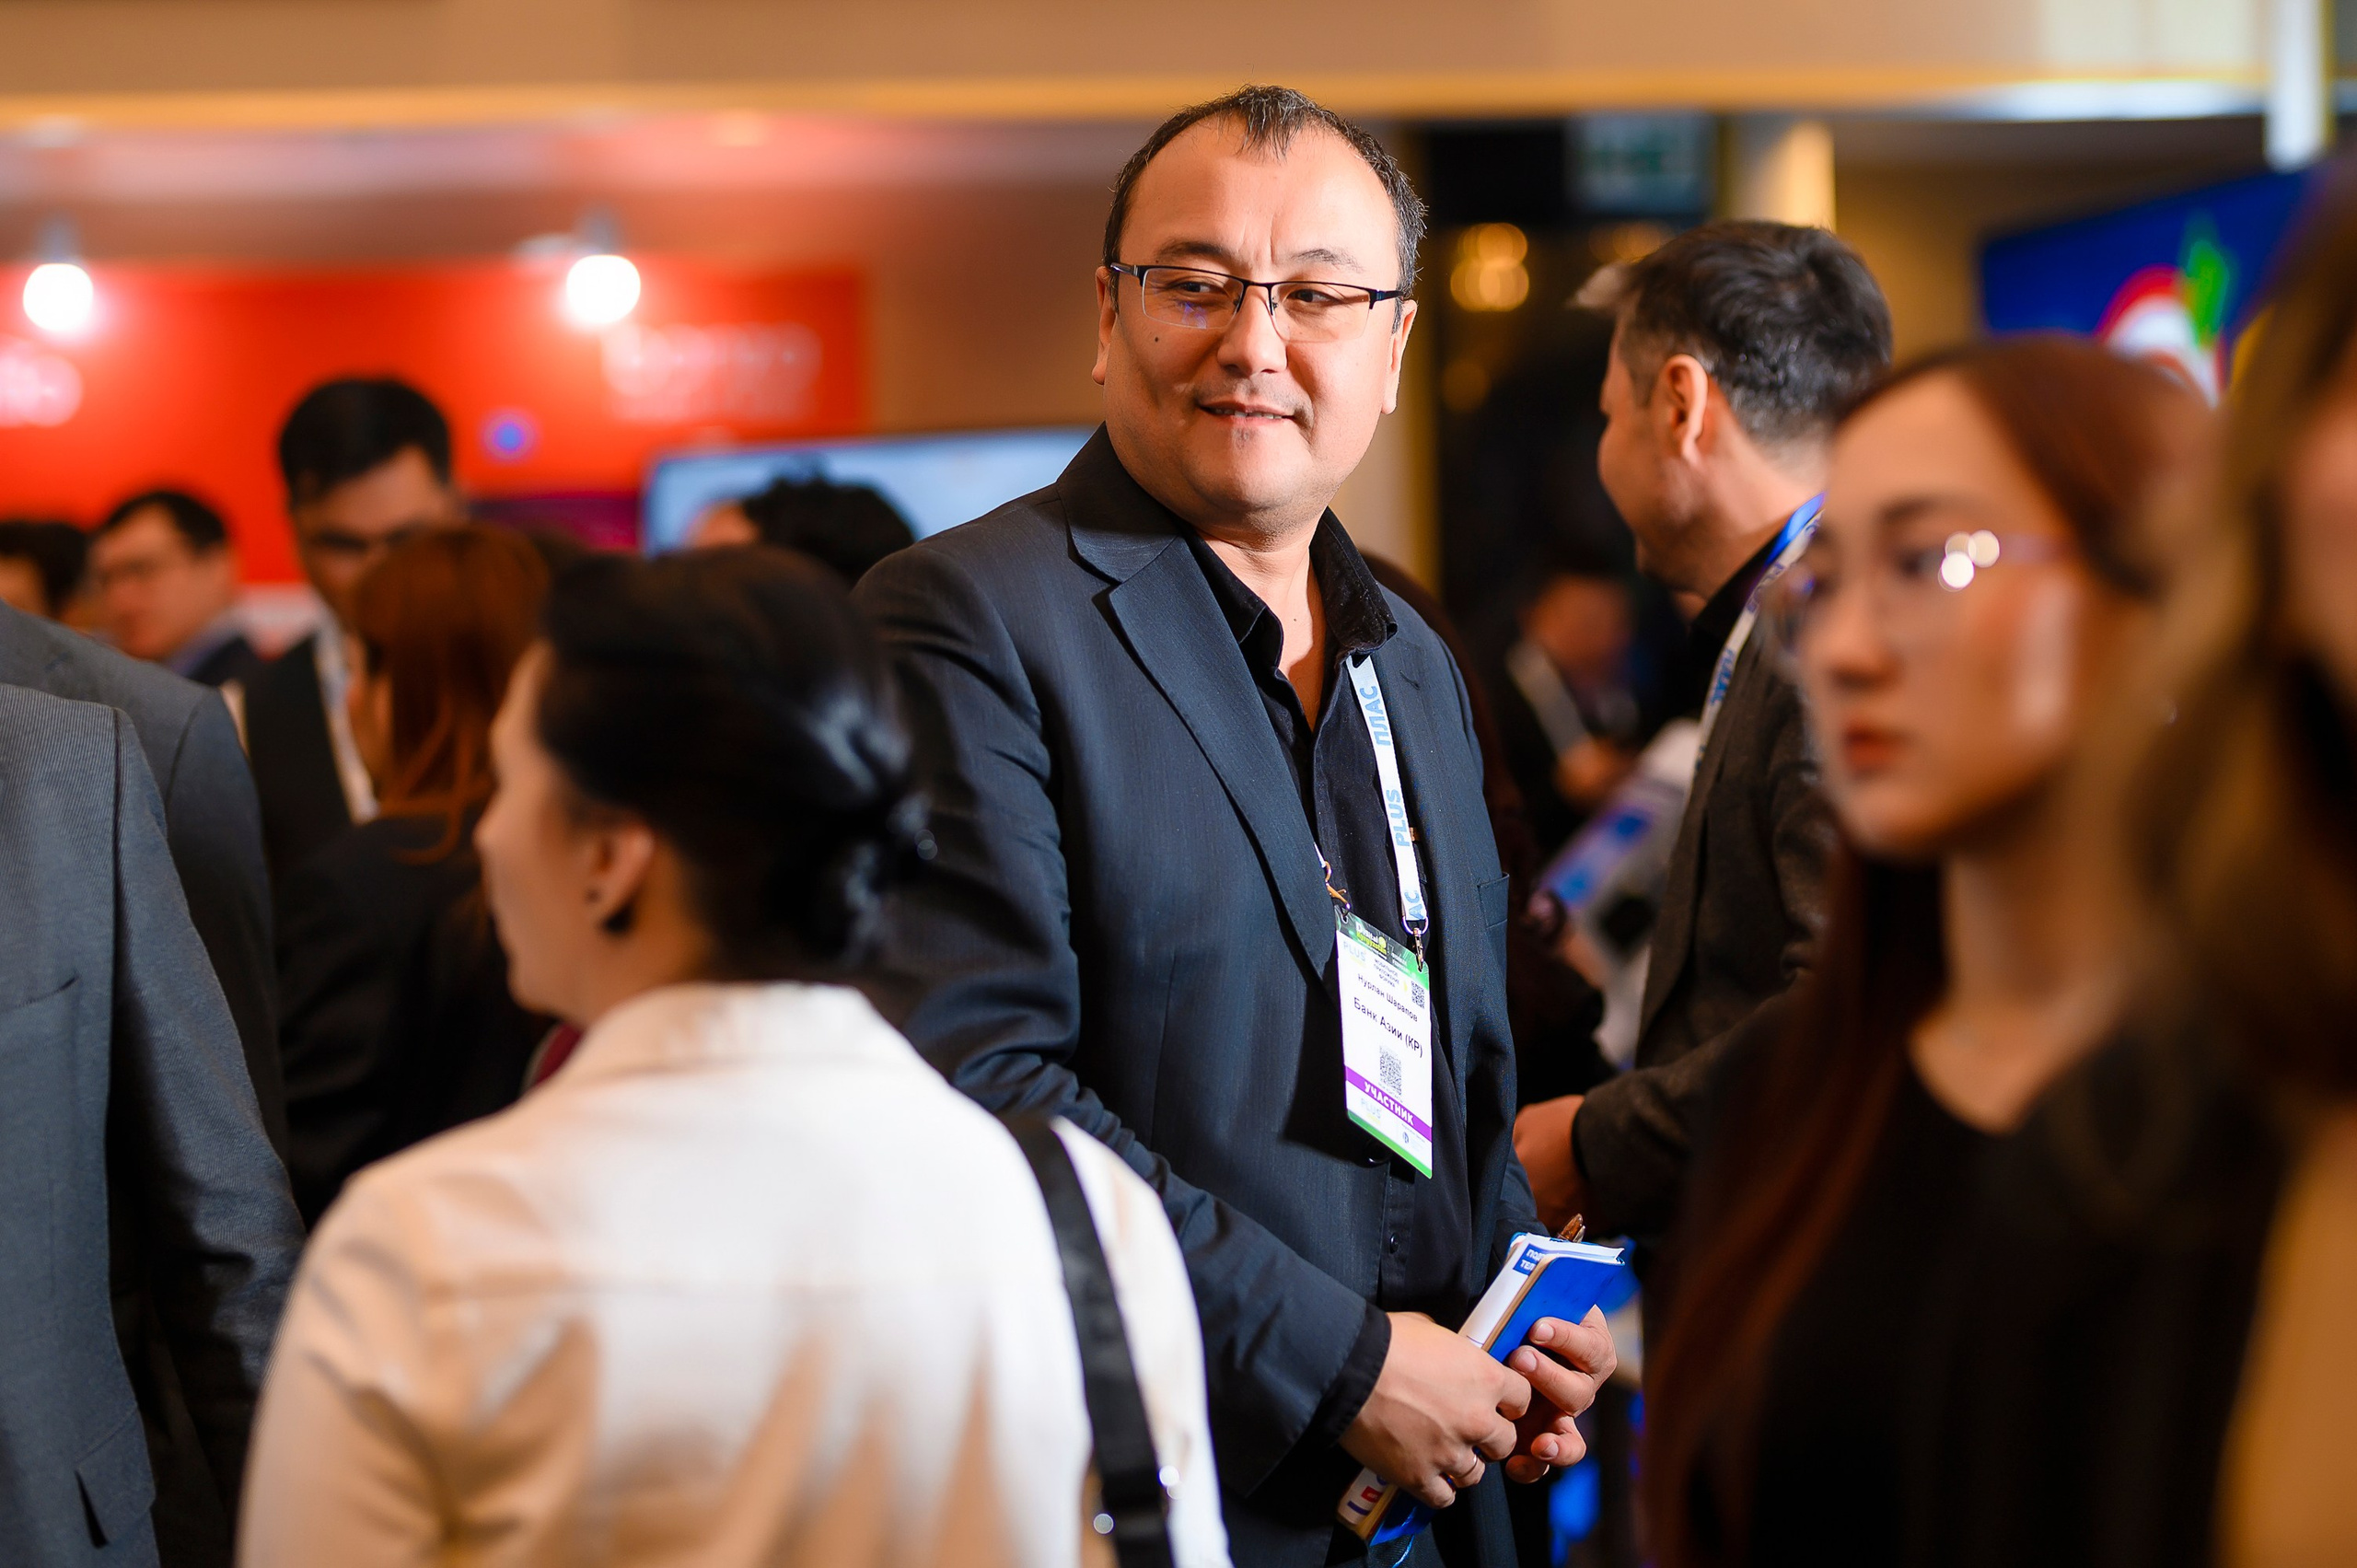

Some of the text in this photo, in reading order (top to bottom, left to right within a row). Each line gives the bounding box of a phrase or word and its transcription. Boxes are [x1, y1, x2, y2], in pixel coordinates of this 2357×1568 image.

[1359, 685, 1391, 747] ПЛАС
[1386, 788, 1411, 847] PLUS
[1353, 996, 1423, 1058] Банк Азии (КР)
[1357, 973, 1418, 1022] Нурлан Шарапов
[1364, 1080, 1414, 1126] УЧАСТНИК
